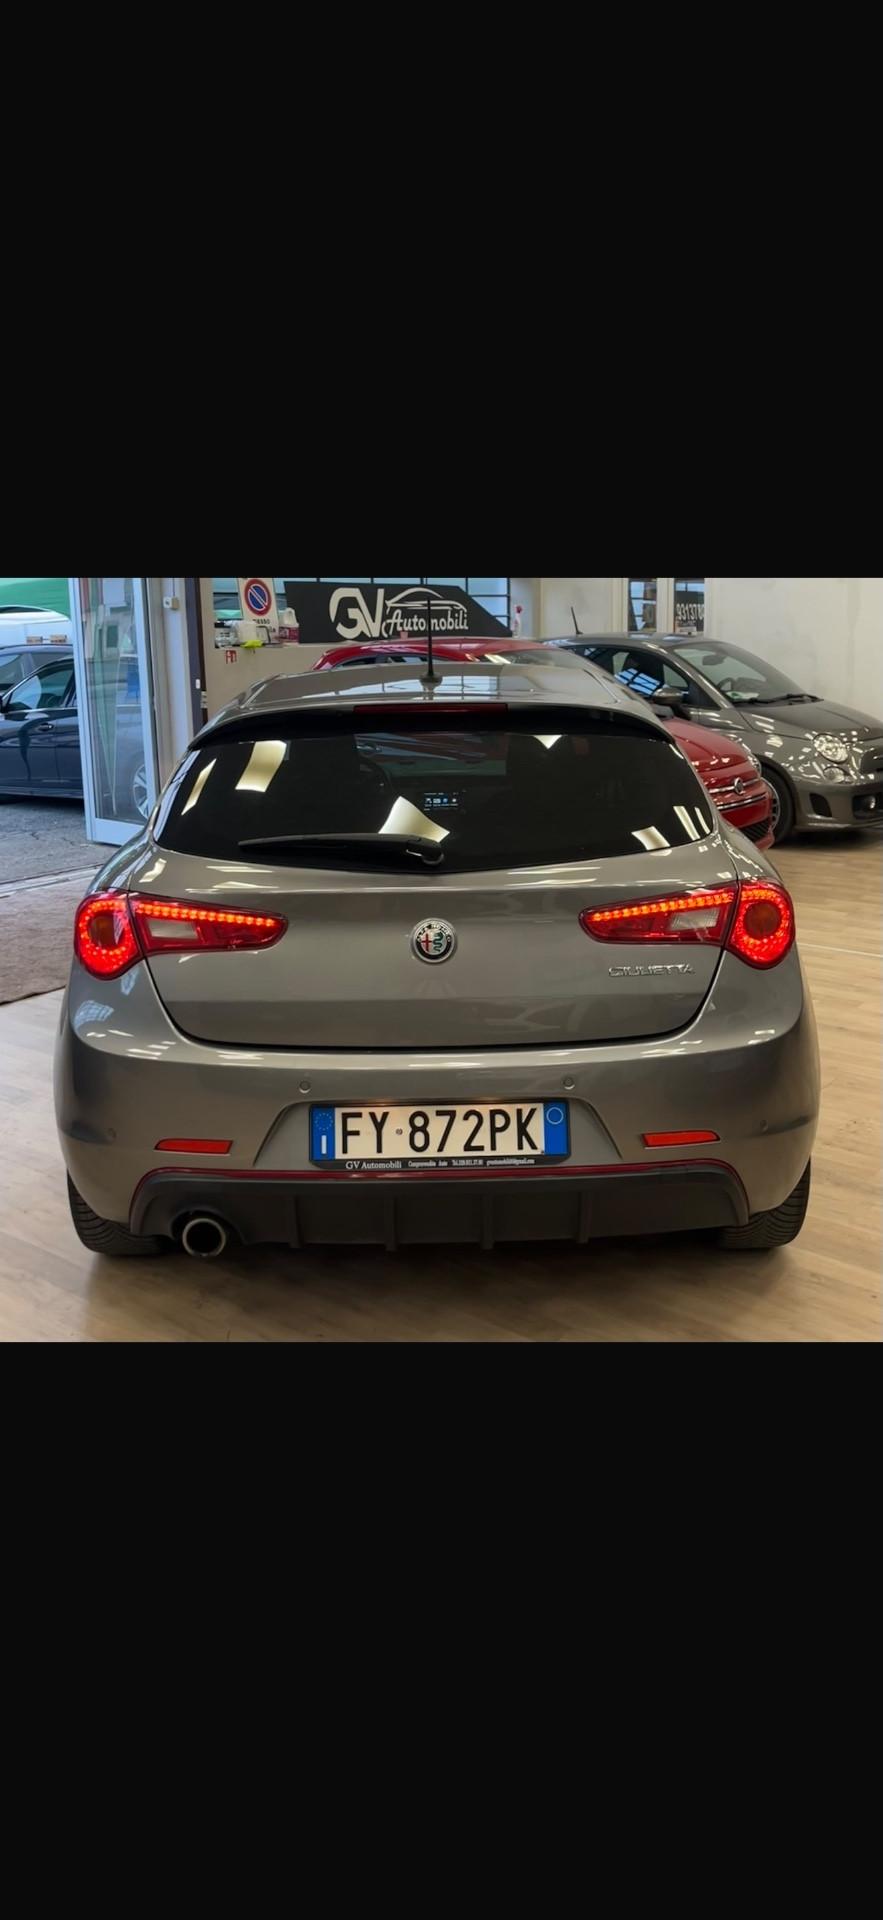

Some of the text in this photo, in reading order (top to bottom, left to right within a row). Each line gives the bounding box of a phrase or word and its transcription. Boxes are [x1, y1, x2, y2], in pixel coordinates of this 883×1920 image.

[329, 587, 469, 639] GV Automobili
[608, 963, 695, 977] GIULIETTA
[341, 1107, 538, 1154] FY 872PK
[345, 1161, 360, 1170] GV
[361, 1160, 402, 1169] Automobili
